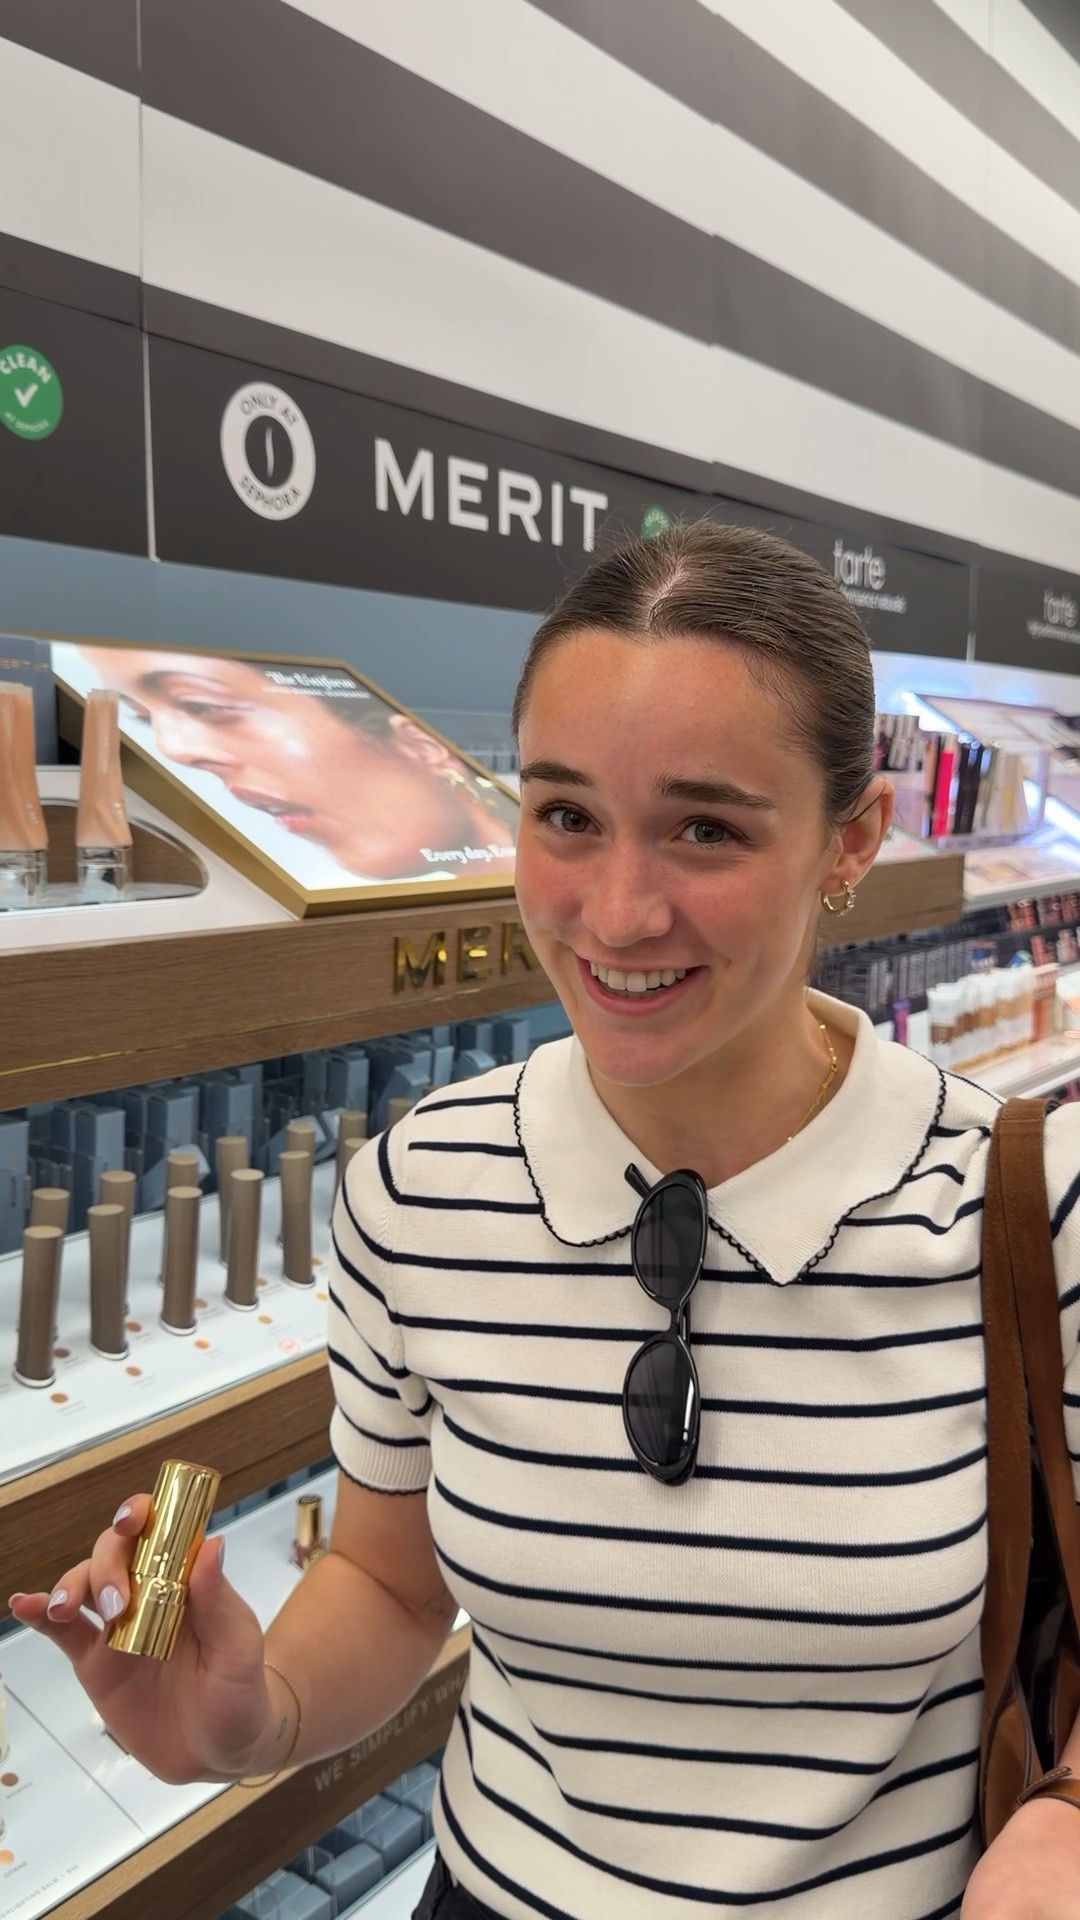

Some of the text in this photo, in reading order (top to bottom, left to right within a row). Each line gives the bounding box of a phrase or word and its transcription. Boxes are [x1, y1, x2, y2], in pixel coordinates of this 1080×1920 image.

[0, 352, 52, 384] CLEAN
[240, 394, 298, 427] ONLY AT
[239, 475, 301, 512] SEPHORA
[374, 436, 608, 553] MERIT
[832, 537, 886, 591] tarte
[314, 1757, 345, 1792] WE
[350, 1699, 428, 1767] SIMPLIFY
